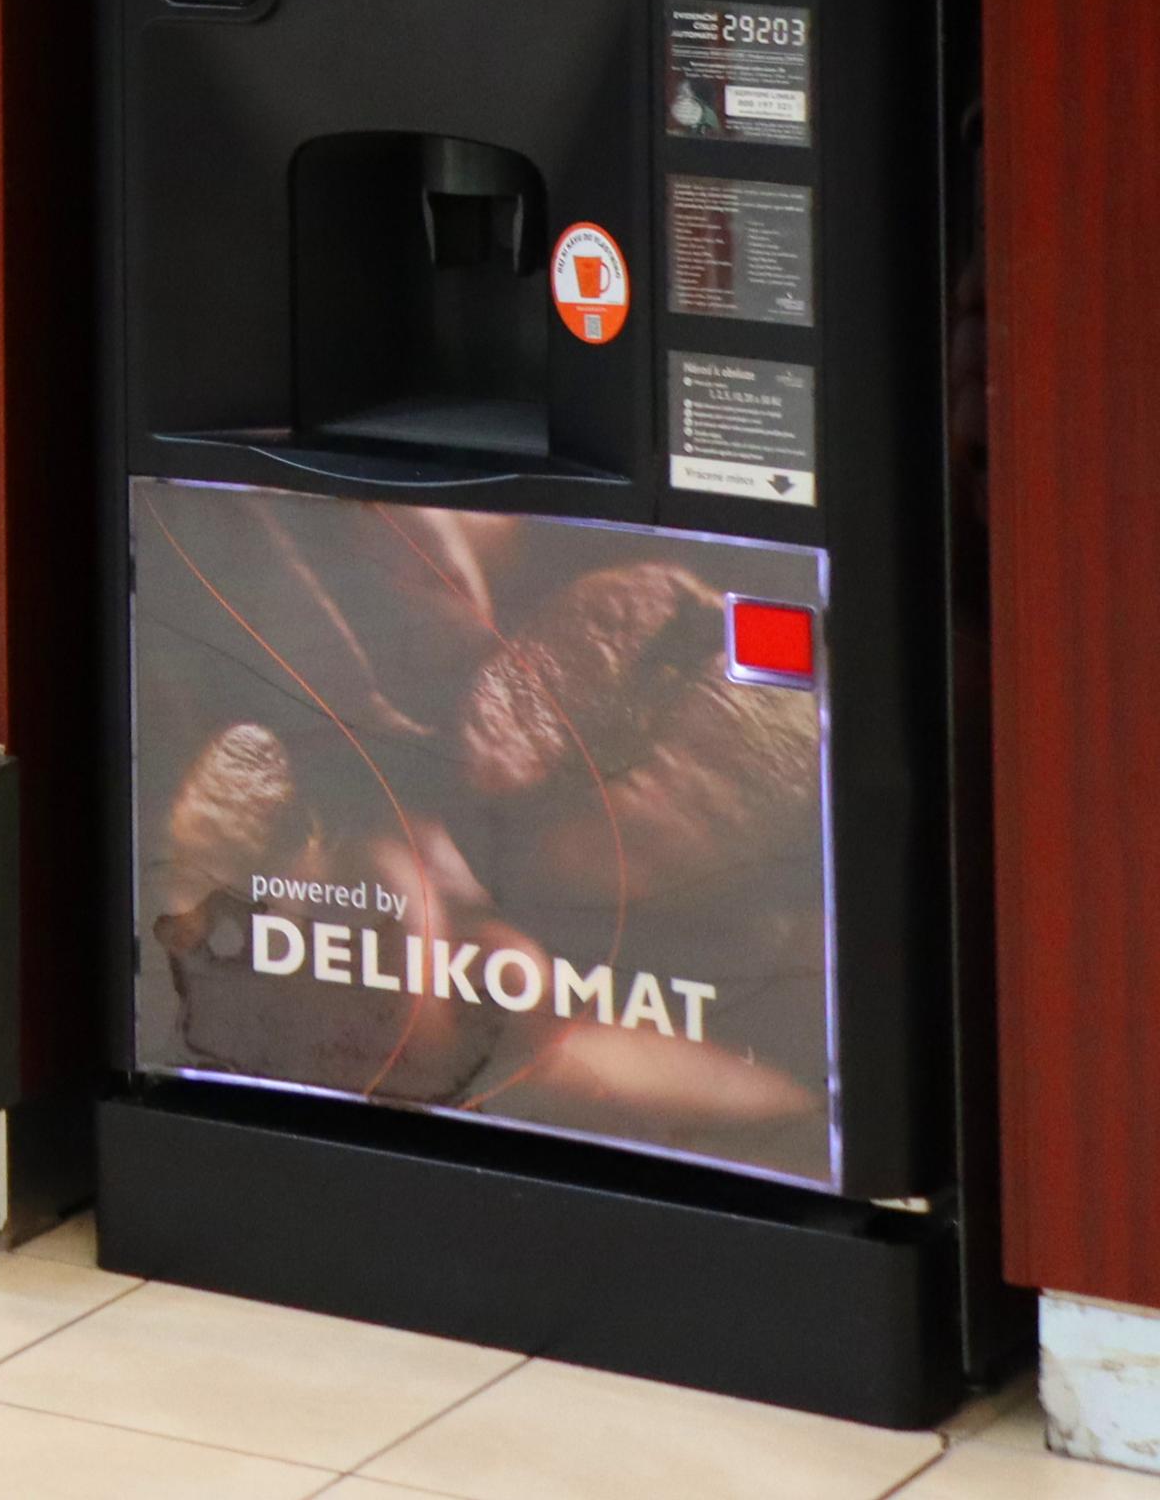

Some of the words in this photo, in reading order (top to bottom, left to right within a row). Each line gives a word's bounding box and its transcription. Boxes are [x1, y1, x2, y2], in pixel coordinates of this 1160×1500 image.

[722, 14, 806, 46] 29203
[251, 873, 367, 909] powered
[375, 883, 408, 921] by
[251, 913, 717, 1043] DELIKOMAT
